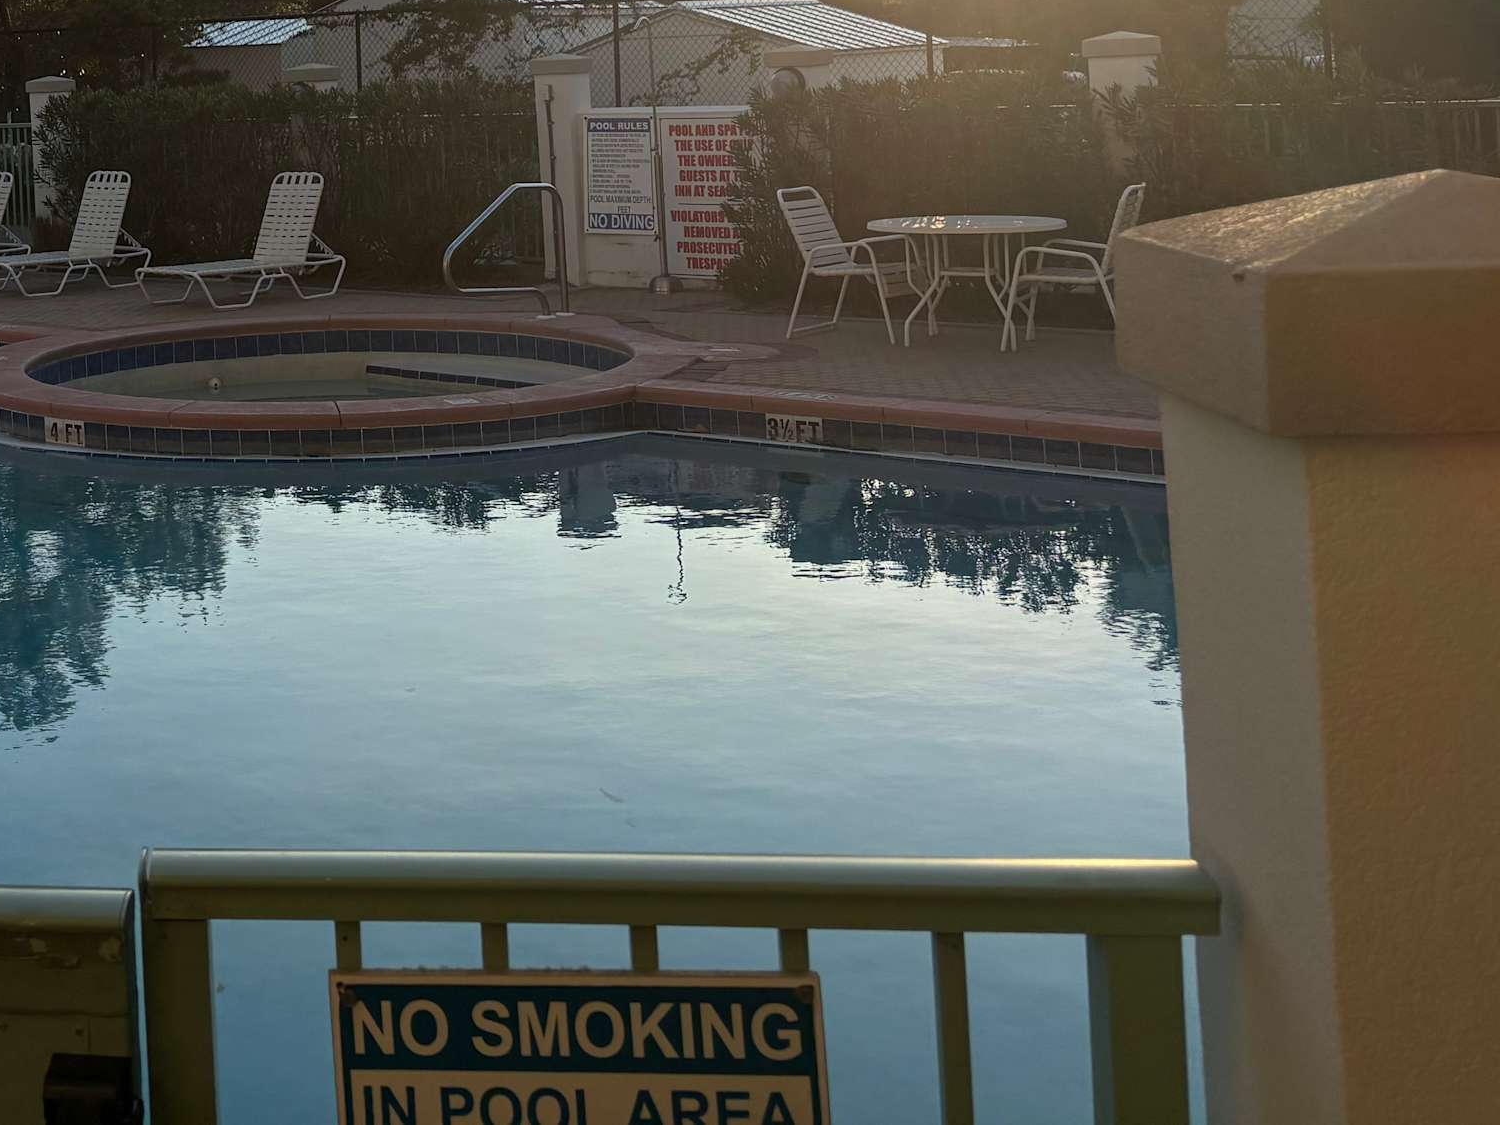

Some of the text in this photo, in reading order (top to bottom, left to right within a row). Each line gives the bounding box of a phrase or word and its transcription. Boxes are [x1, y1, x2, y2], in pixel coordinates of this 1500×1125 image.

[590, 122, 649, 130] POOL RULES
[669, 124, 693, 136] POOL
[695, 124, 715, 136] AND
[717, 124, 738, 136] SPA
[675, 139, 693, 151] THE
[695, 139, 714, 151] USE
[716, 139, 728, 151] OF
[677, 155, 696, 167] THE
[680, 170, 717, 182] GUESTS
[719, 170, 731, 182] AT
[675, 185, 692, 197] INN
[693, 185, 705, 197] AT
[590, 195, 652, 204] POOL MAXIMUM DEPTH
[590, 214, 654, 230] NO DIVING
[670, 210, 724, 223] VIOLATORS
[684, 226, 730, 238] REMOVED
[676, 241, 740, 254] PROSECUTED
[51, 422, 83, 444] 4 FT
[796, 421, 820, 443] FT
[352, 999, 804, 1062] NO SMOKING
[363, 1086, 797, 1125] IN POOL AREA
